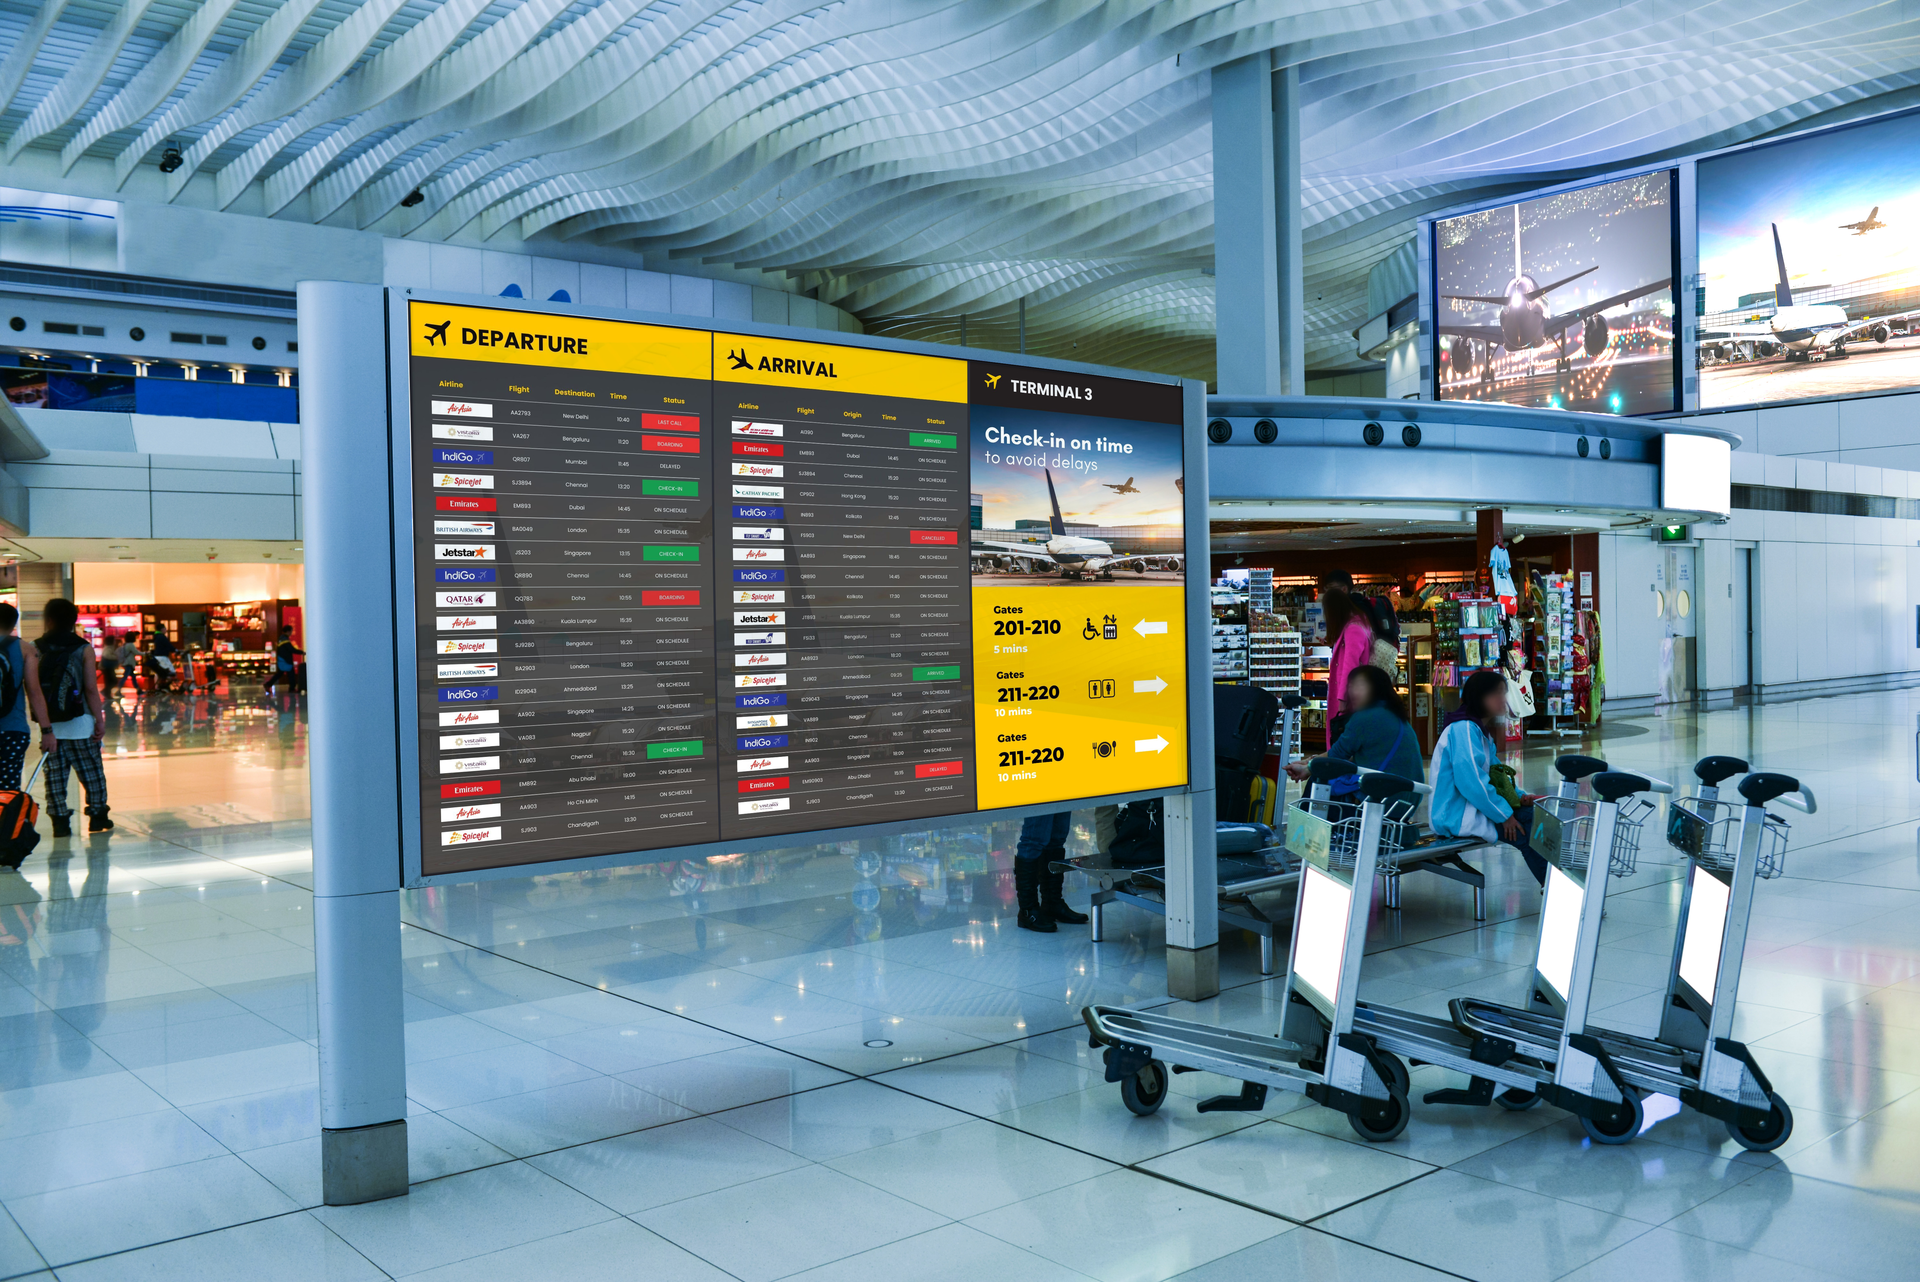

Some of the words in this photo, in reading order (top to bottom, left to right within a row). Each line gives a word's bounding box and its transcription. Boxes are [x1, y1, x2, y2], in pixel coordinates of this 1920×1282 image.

[462, 327, 588, 355] DEPARTURE
[758, 356, 837, 378] ARRIVAL
[439, 380, 464, 388] Airline
[509, 386, 530, 394] Flight
[555, 389, 595, 398] Destination
[1010, 379, 1081, 400] TERMINAL
[1084, 388, 1093, 400] 3
[448, 403, 472, 414] AirAsia
[843, 411, 862, 419] Origin
[985, 426, 1065, 448] Check-in
[1070, 436, 1091, 450] on
[1096, 437, 1133, 454] time
[442, 452, 473, 462] IndiGo
[985, 451, 1000, 464] to
[1005, 452, 1048, 469] avoid
[1052, 453, 1098, 474] delays
[450, 500, 479, 508] Emirates
[740, 508, 766, 517] IndiGo
[443, 548, 477, 557] Jetstar
[746, 550, 767, 559] AirAsia
[445, 571, 475, 580] IndiGo
[741, 572, 767, 580] IndiGo
[446, 595, 472, 603] QATAR
[993, 606, 1023, 614] Gates
[452, 618, 476, 628] AirAsia
[740, 615, 770, 623] Jetstar
[993, 619, 1061, 636] 201-210
[993, 645, 1000, 654] 5
[1002, 644, 1028, 653] mins
[748, 655, 769, 664] AirAsia
[996, 671, 1024, 679] Gates
[448, 688, 478, 699] IndiGo
[997, 685, 1060, 703] 211-220
[743, 697, 769, 705] IndiGo
[995, 708, 1006, 717] 10
[1008, 707, 1032, 716] mins
[455, 713, 479, 724] AirAsia
[997, 733, 1027, 742] Gates
[745, 738, 771, 748] IndiGo
[998, 746, 1064, 767] 211-220
[750, 759, 771, 769] AirAsia
[998, 773, 1009, 782] 10
[1012, 770, 1037, 781] mins
[455, 786, 483, 794] Emirates
[750, 781, 774, 789] Emirates
[456, 807, 481, 819] AirAsia
